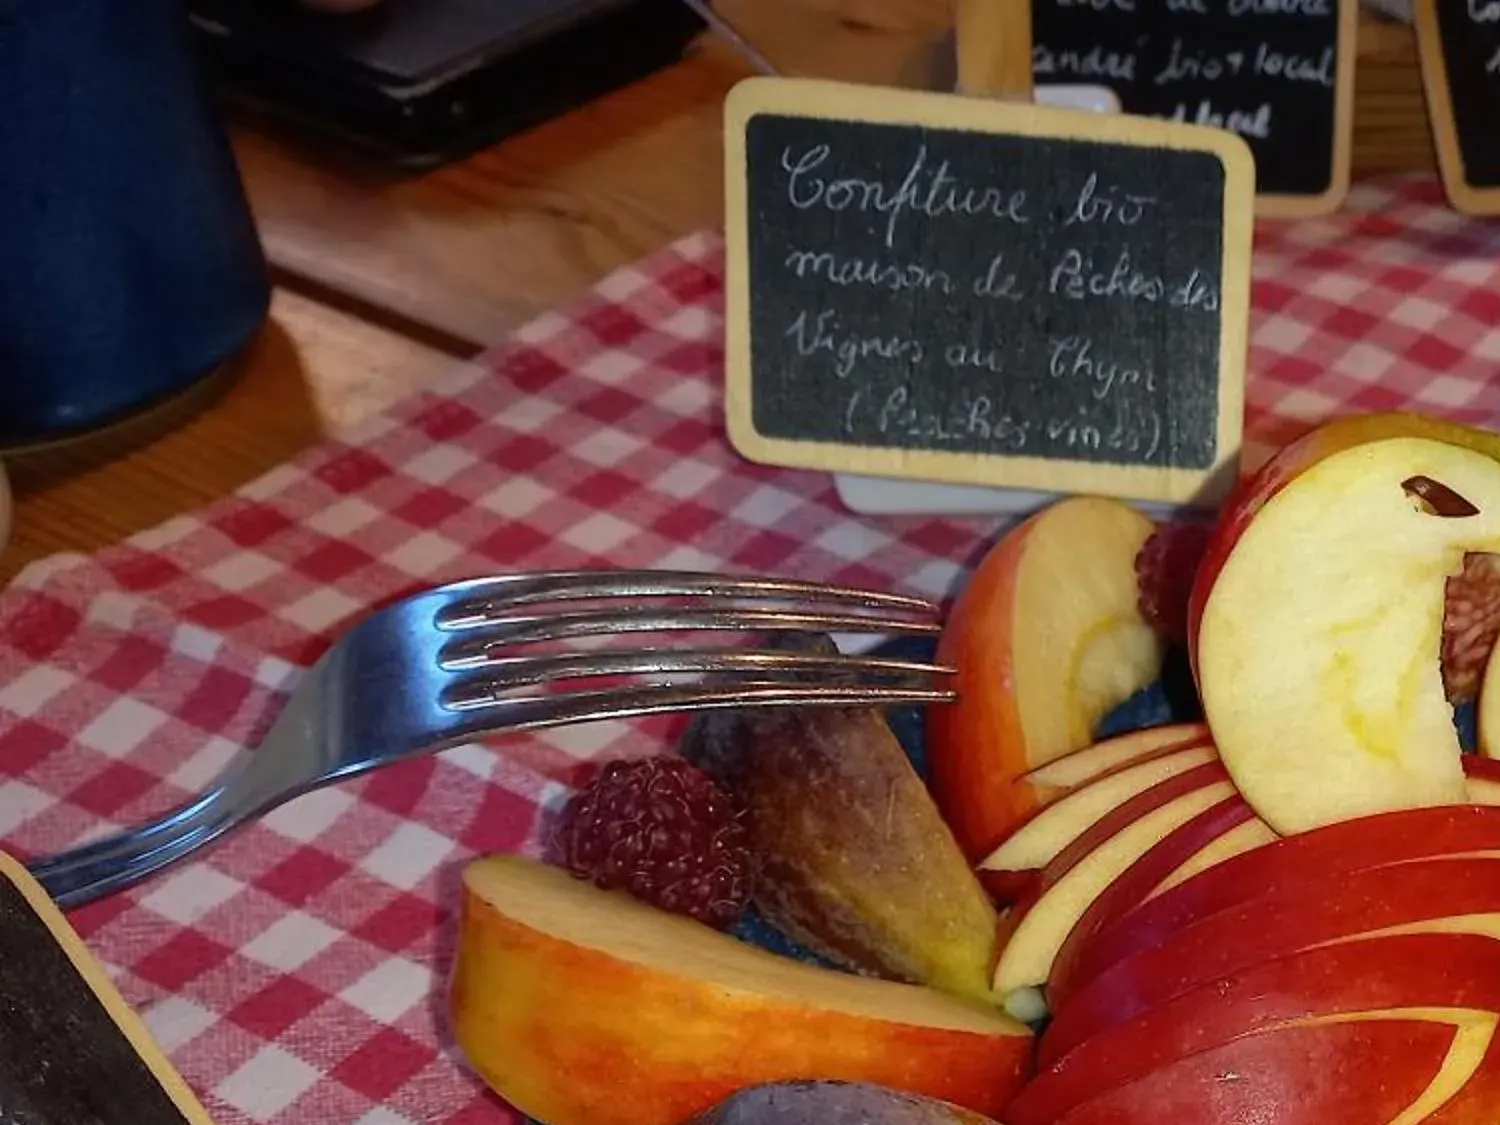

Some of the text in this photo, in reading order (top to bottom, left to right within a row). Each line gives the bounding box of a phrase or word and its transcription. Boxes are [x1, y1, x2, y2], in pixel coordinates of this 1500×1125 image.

[1255, 41, 1335, 88] local
[781, 143, 1155, 247] Confiture bio
[785, 246, 951, 296] maison
[974, 255, 1023, 301] de
[944, 342, 1002, 373] au
